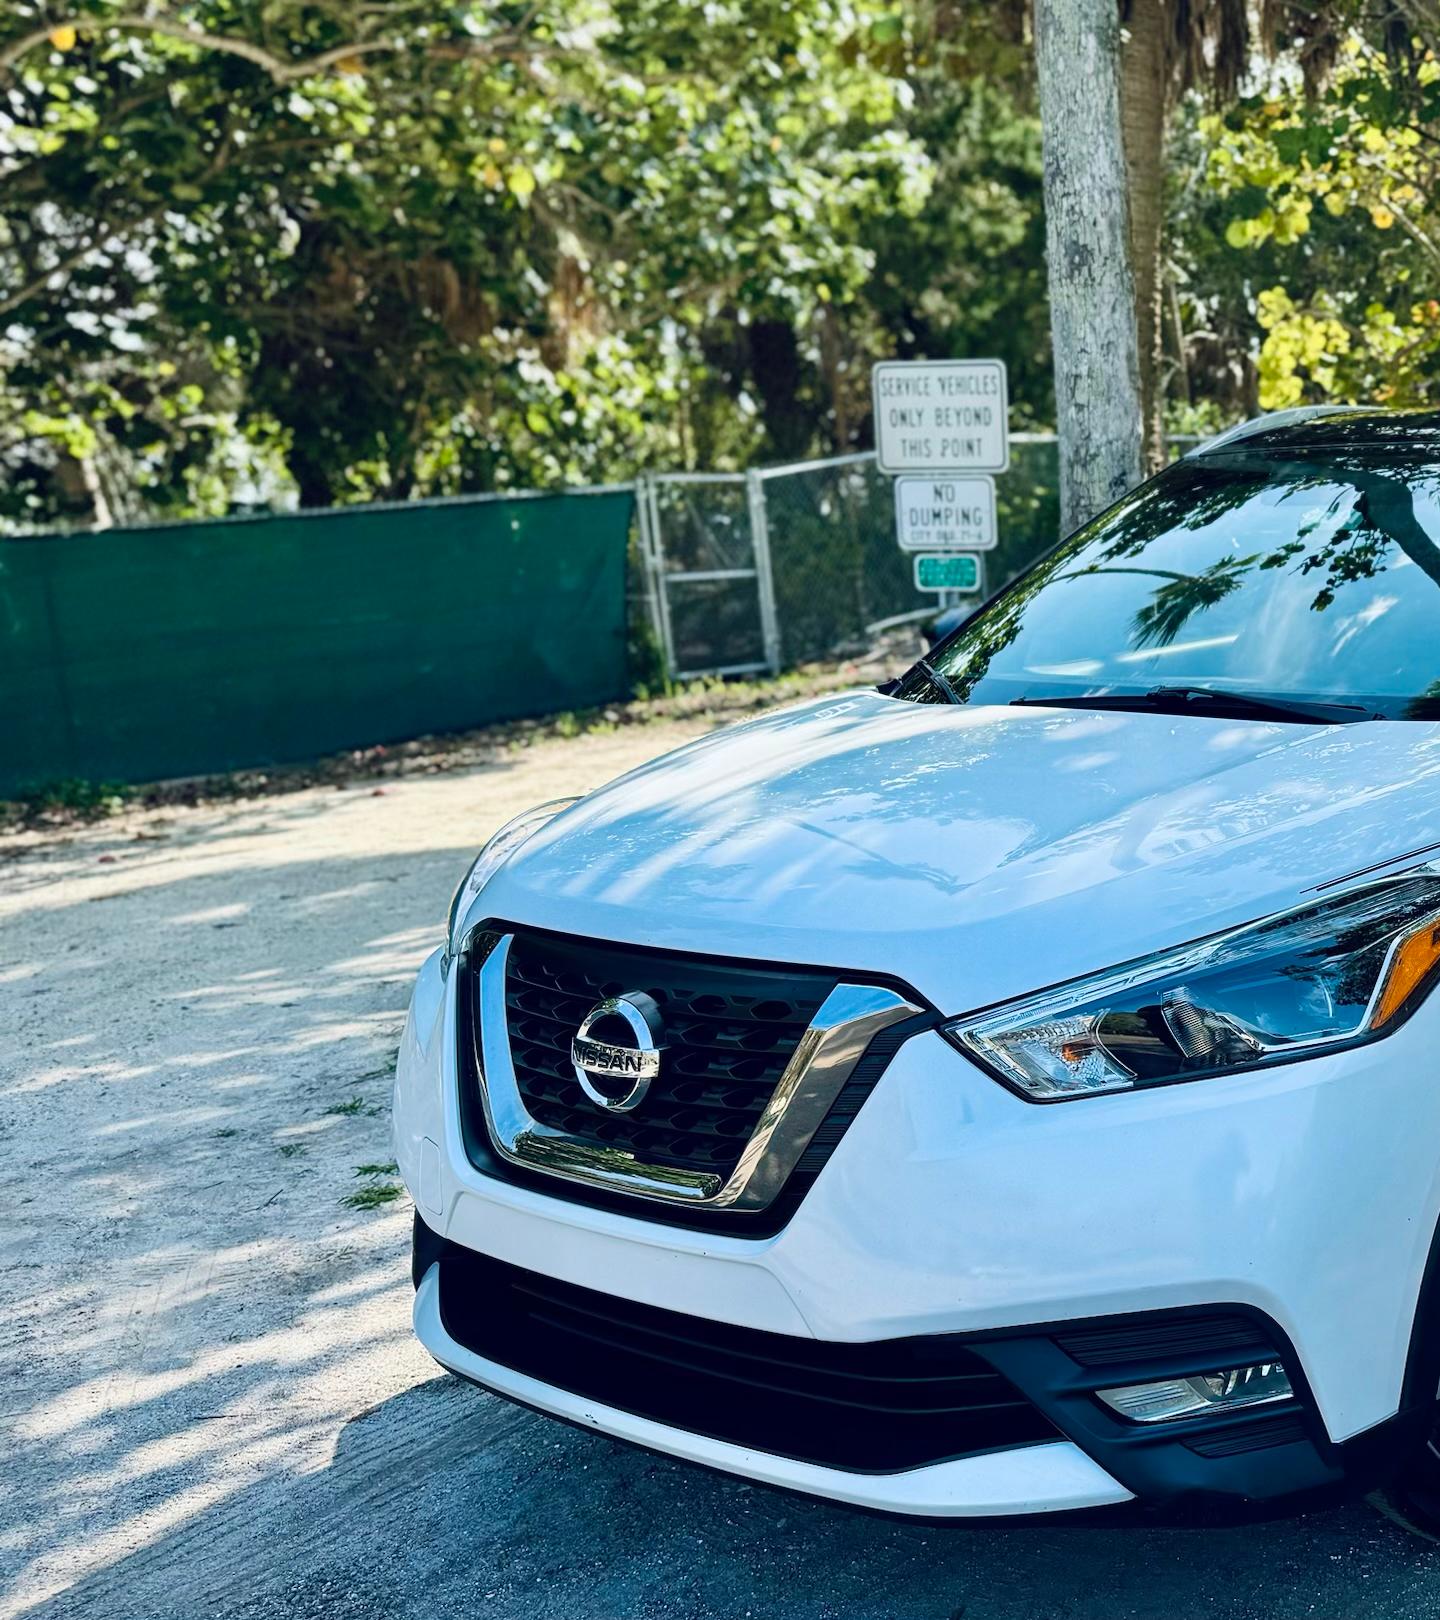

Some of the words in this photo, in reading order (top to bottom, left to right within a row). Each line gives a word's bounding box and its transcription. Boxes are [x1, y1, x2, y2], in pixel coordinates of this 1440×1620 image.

[881, 376, 931, 397] SERVICE
[938, 375, 997, 396] VEHICLES
[889, 408, 924, 428] ONLY
[935, 407, 991, 427] BEYOND
[901, 439, 931, 459] THIS
[940, 438, 982, 458] POINT
[933, 484, 955, 503] NO
[909, 507, 983, 527] DUMPING
[573, 1044, 642, 1072] NISSAN
